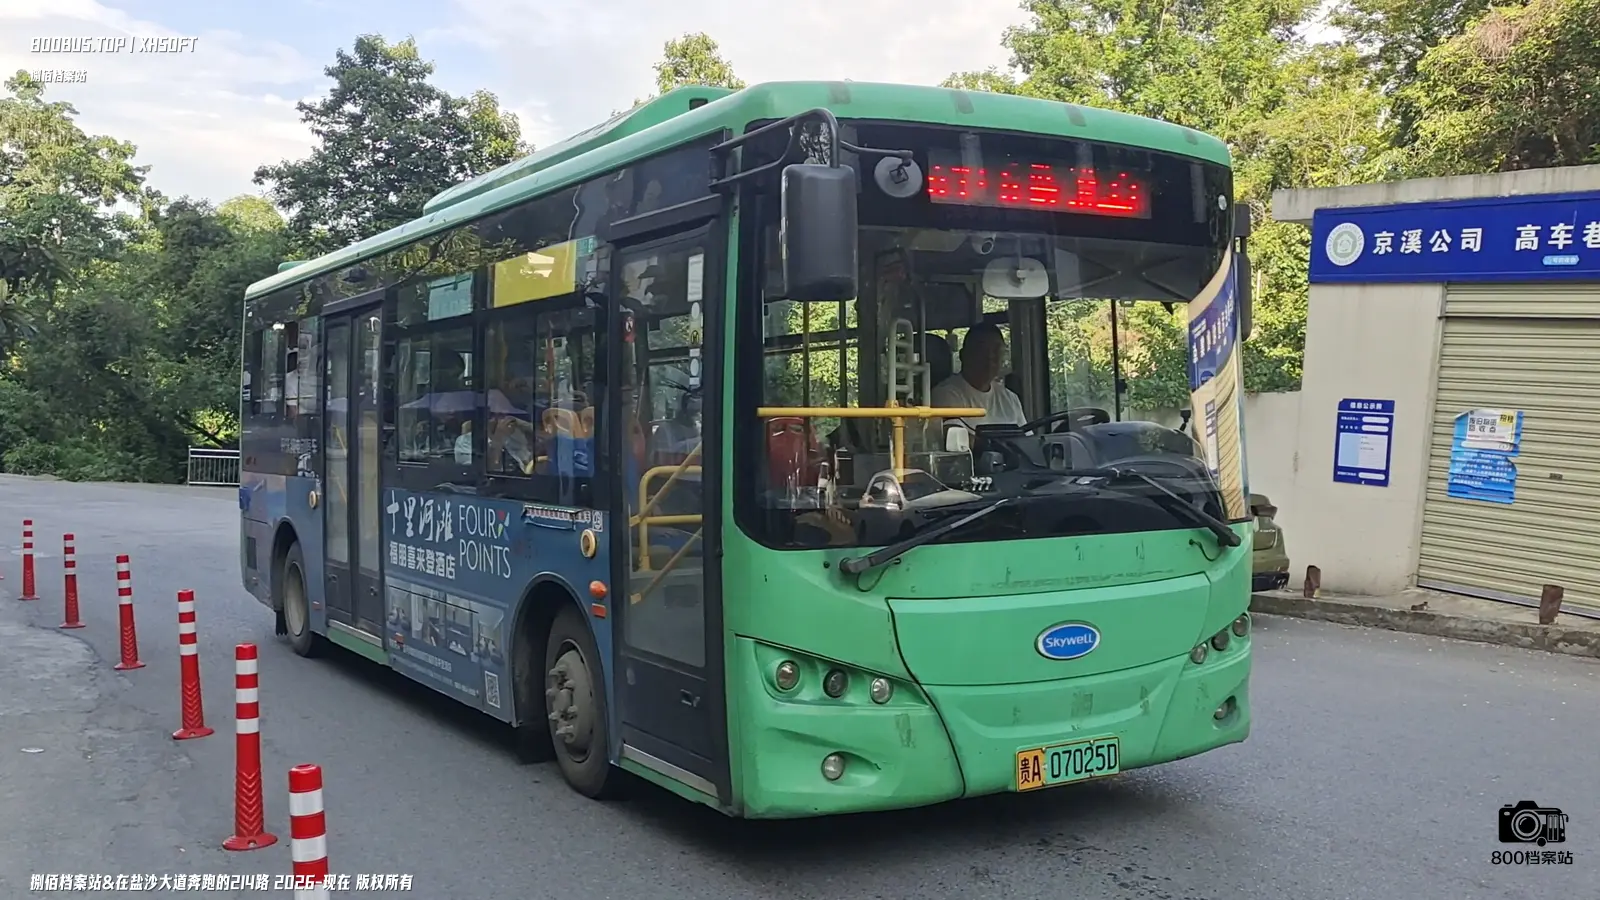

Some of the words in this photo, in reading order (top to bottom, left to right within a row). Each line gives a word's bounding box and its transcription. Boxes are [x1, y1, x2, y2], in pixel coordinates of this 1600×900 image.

[1372, 227, 1483, 255] 京溪公司
[1515, 220, 1600, 251] 高车巷
[386, 490, 453, 543] 十里河滩
[458, 504, 497, 539] FOUR
[389, 540, 456, 580] 福朋喜来登酒店
[459, 539, 512, 579] POINTS
[1045, 633, 1094, 648] Skywell
[1020, 755, 1042, 785] 贵A
[1051, 743, 1118, 779] 07025D
